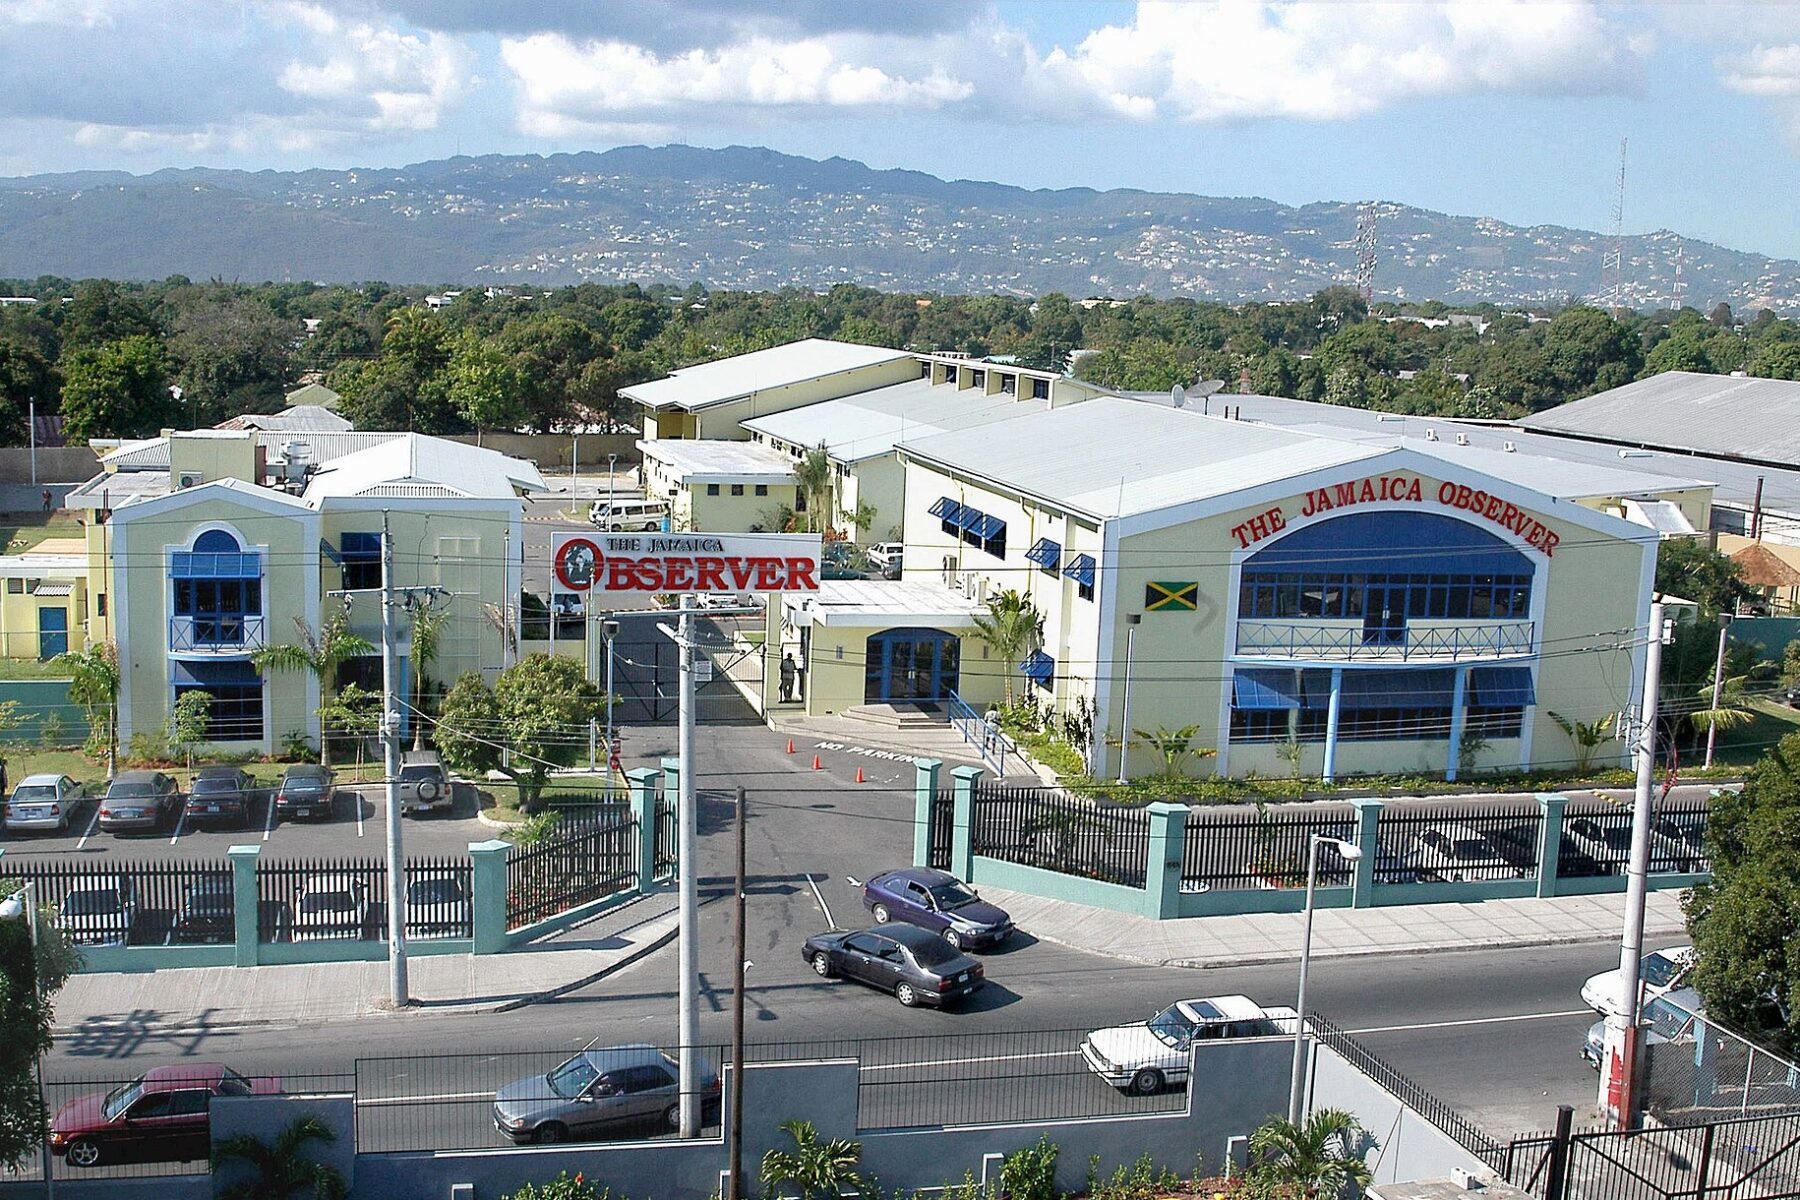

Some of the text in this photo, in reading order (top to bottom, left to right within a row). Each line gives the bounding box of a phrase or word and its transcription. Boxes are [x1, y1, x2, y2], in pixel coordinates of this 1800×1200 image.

[1231, 477, 1560, 558] THE JAMAICA OBSERVER
[606, 538, 724, 552] THE JAMAICA
[813, 741, 914, 763] NO PARKIN
